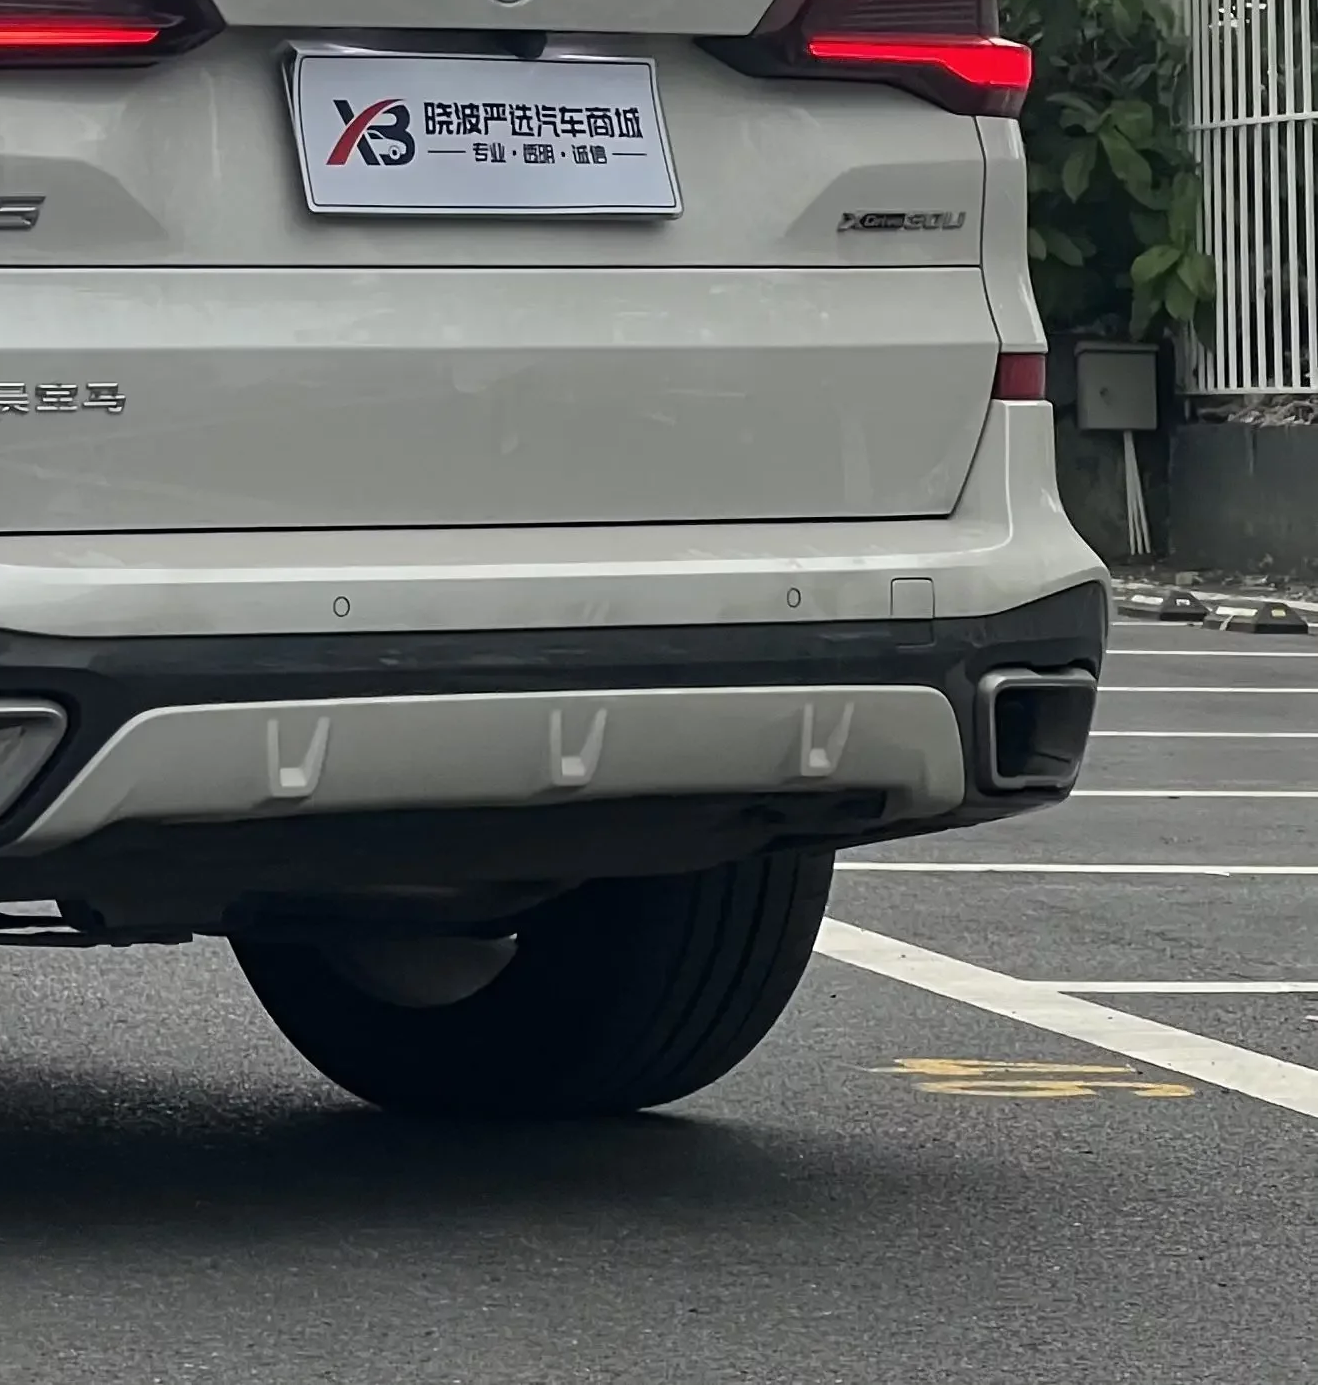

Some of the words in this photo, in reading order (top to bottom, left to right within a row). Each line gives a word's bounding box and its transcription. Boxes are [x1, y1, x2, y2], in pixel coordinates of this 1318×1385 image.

[423, 101, 644, 139] 晓波严选汽车商城
